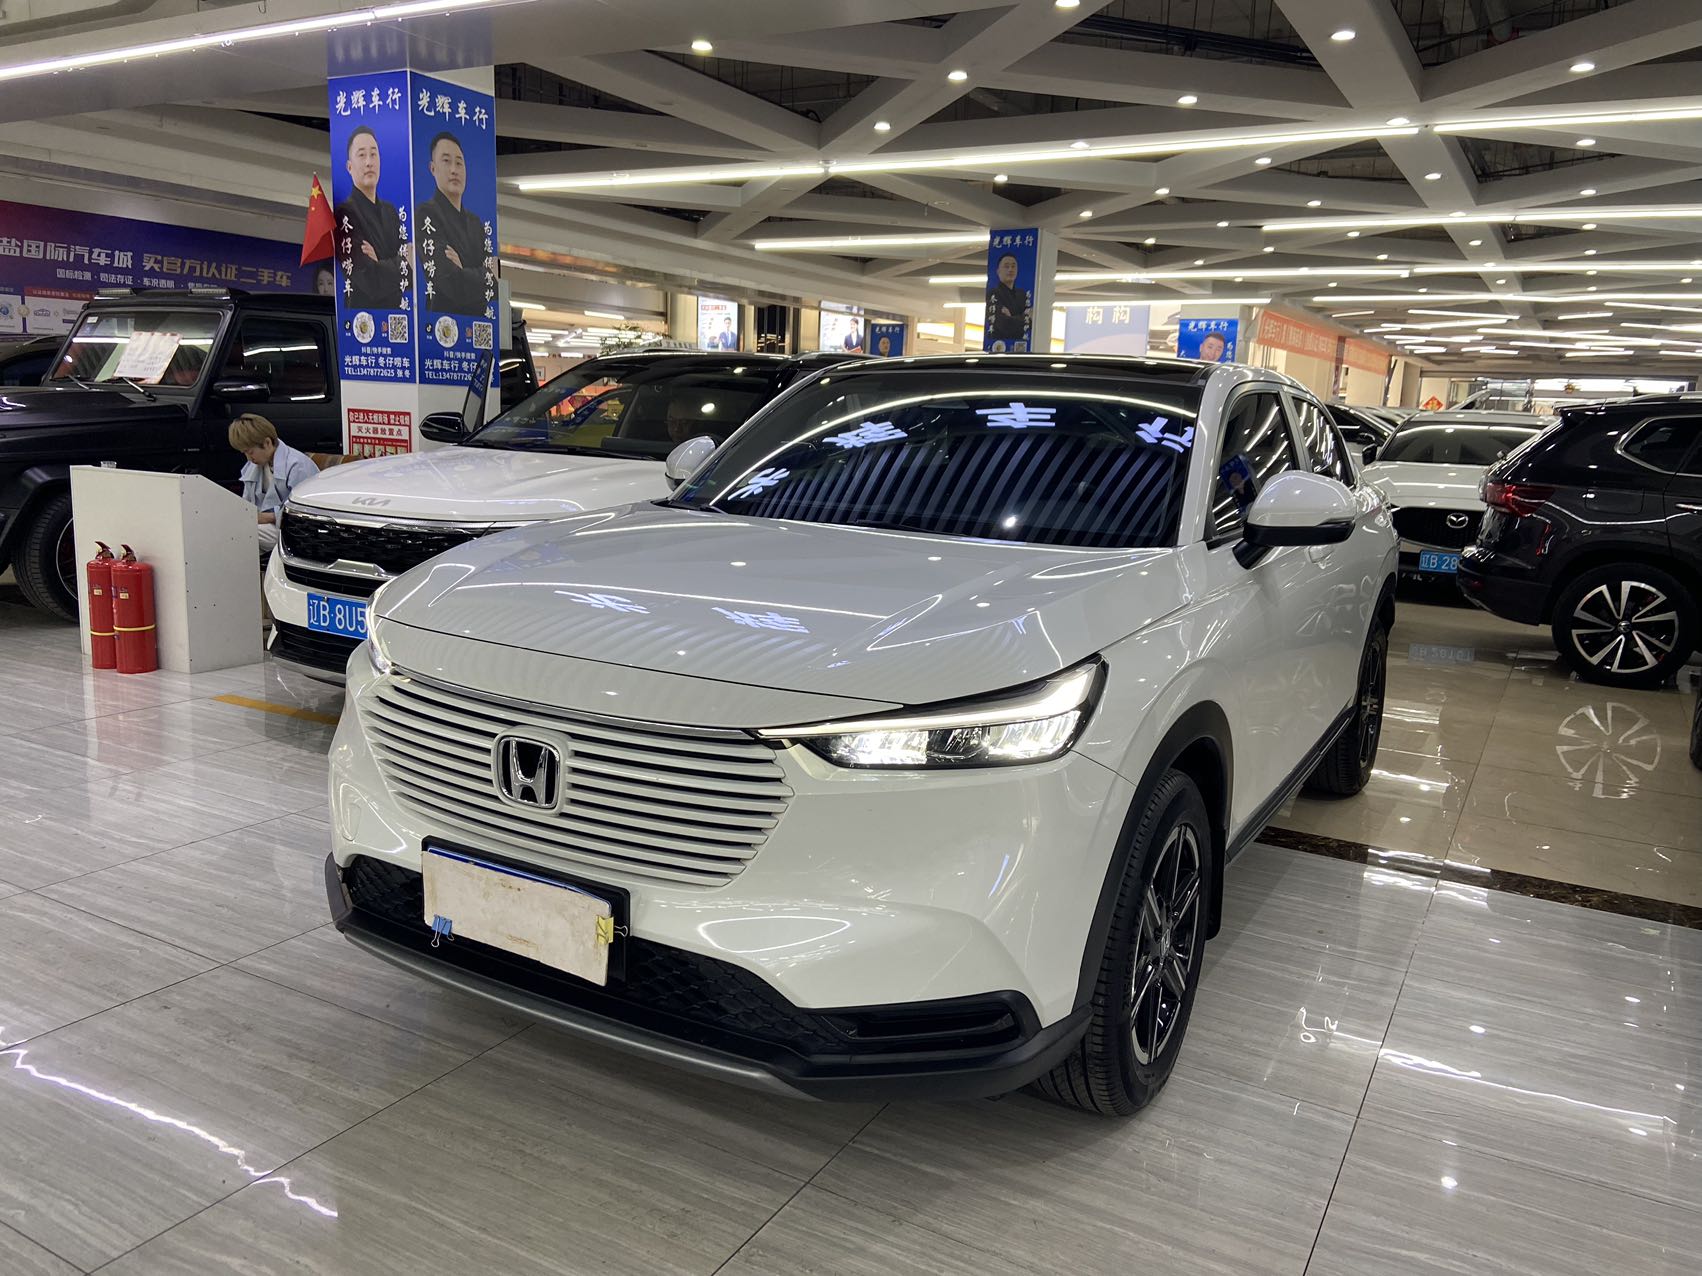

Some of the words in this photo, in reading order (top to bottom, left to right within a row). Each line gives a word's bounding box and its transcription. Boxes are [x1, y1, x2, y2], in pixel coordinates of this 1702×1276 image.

[335, 87, 402, 117] 光辉车行
[417, 88, 489, 130] 光辉车行
[142, 253, 292, 288] 买官方认证二手车
[398, 205, 411, 312] 为您保驾护航
[483, 220, 497, 320] 为您保驾护航
[344, 355, 376, 367] 光辉车行
[424, 358, 459, 371] 光辉车行
[461, 360, 479, 373] 冬仔
[424, 371, 475, 381] TEL:134787726
